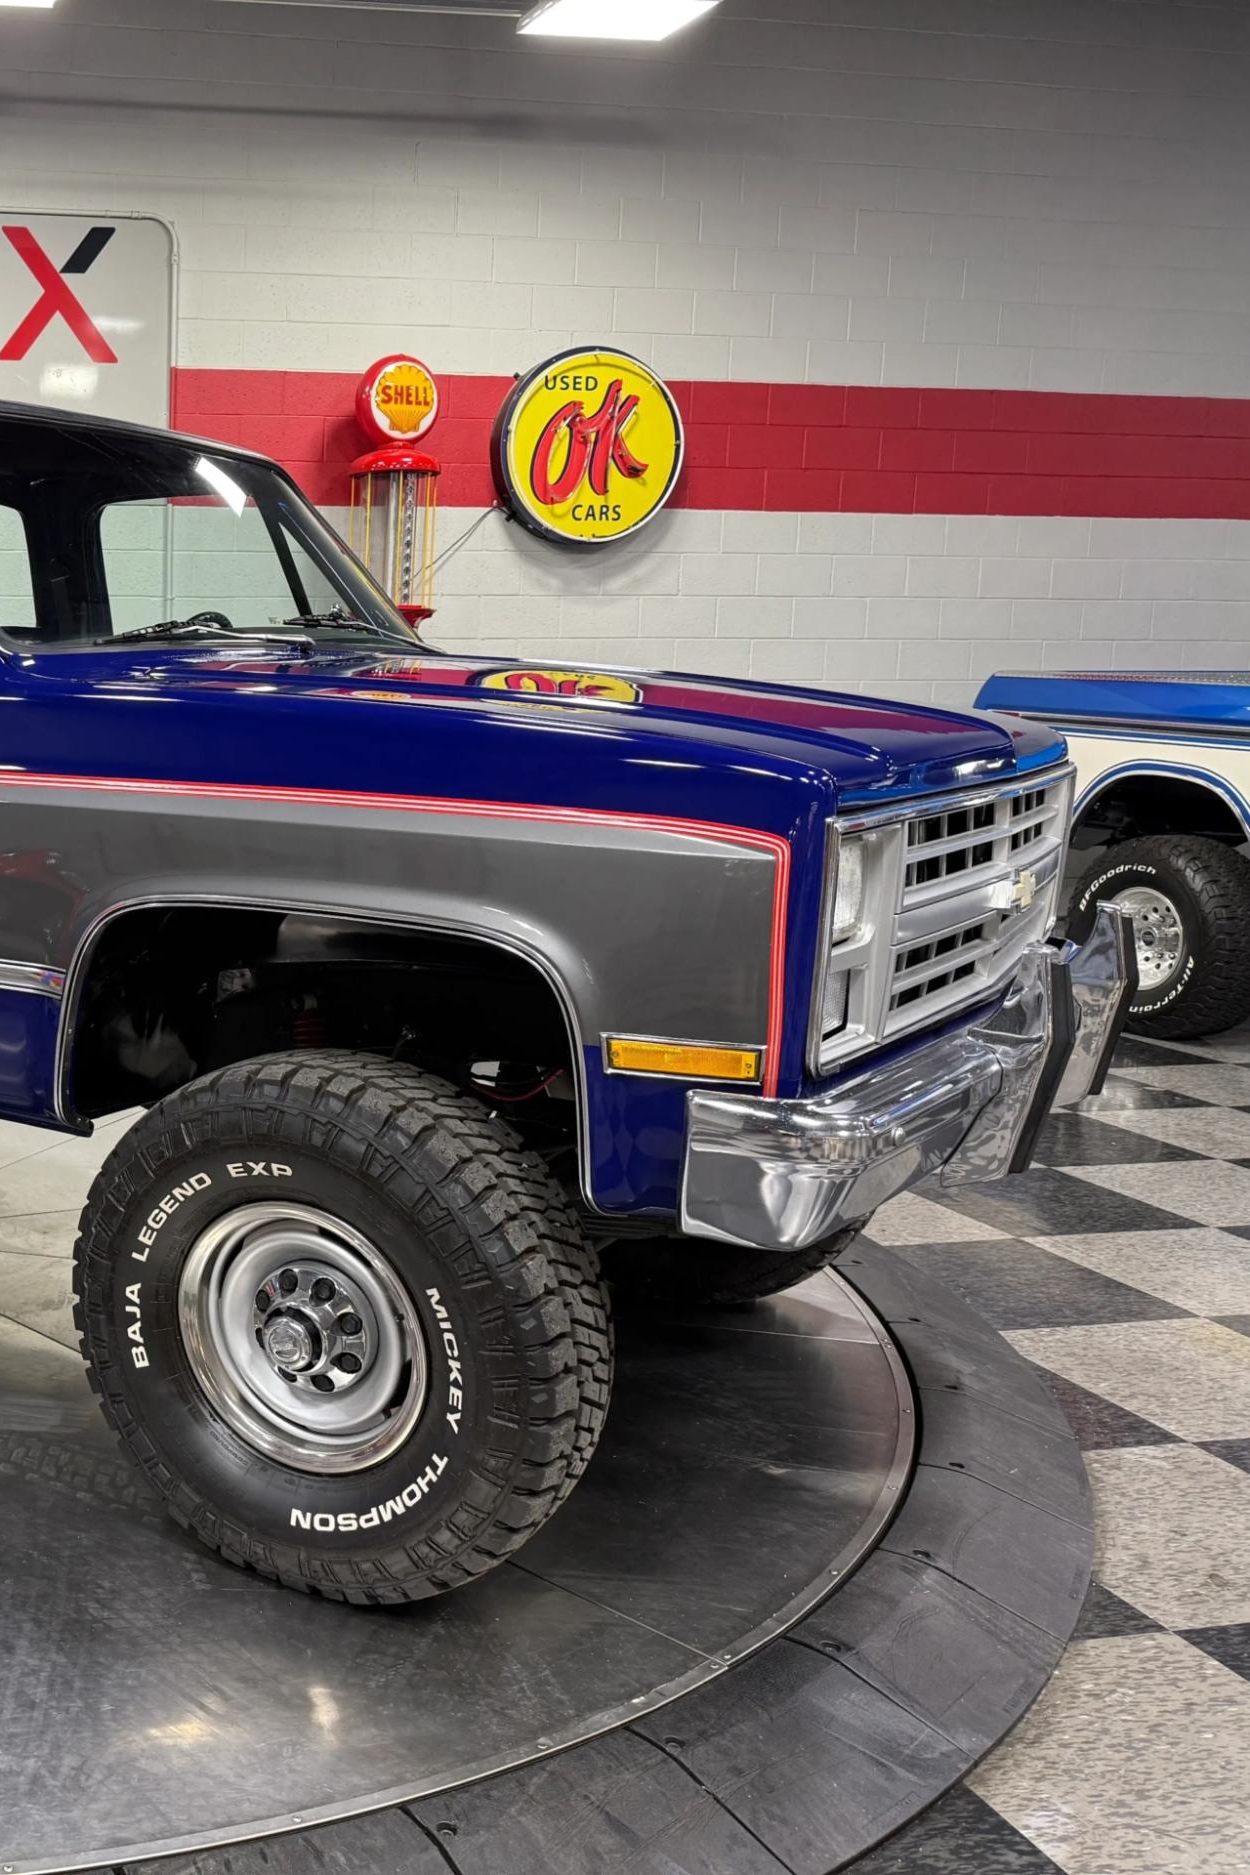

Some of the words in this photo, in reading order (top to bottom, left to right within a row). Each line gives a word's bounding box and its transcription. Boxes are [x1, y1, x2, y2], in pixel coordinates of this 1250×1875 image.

[380, 384, 430, 407] SHELL
[544, 375, 599, 392] USED
[530, 378, 649, 505] OK
[571, 503, 622, 522] CARS
[1079, 863, 1157, 912] BFGoodrich
[225, 1161, 293, 1178] EXP
[131, 1171, 212, 1262] LEGEND
[125, 1282, 150, 1369] BAJA
[425, 1287, 463, 1435] MICKEY
[289, 1453, 449, 1532] THOMPSON
